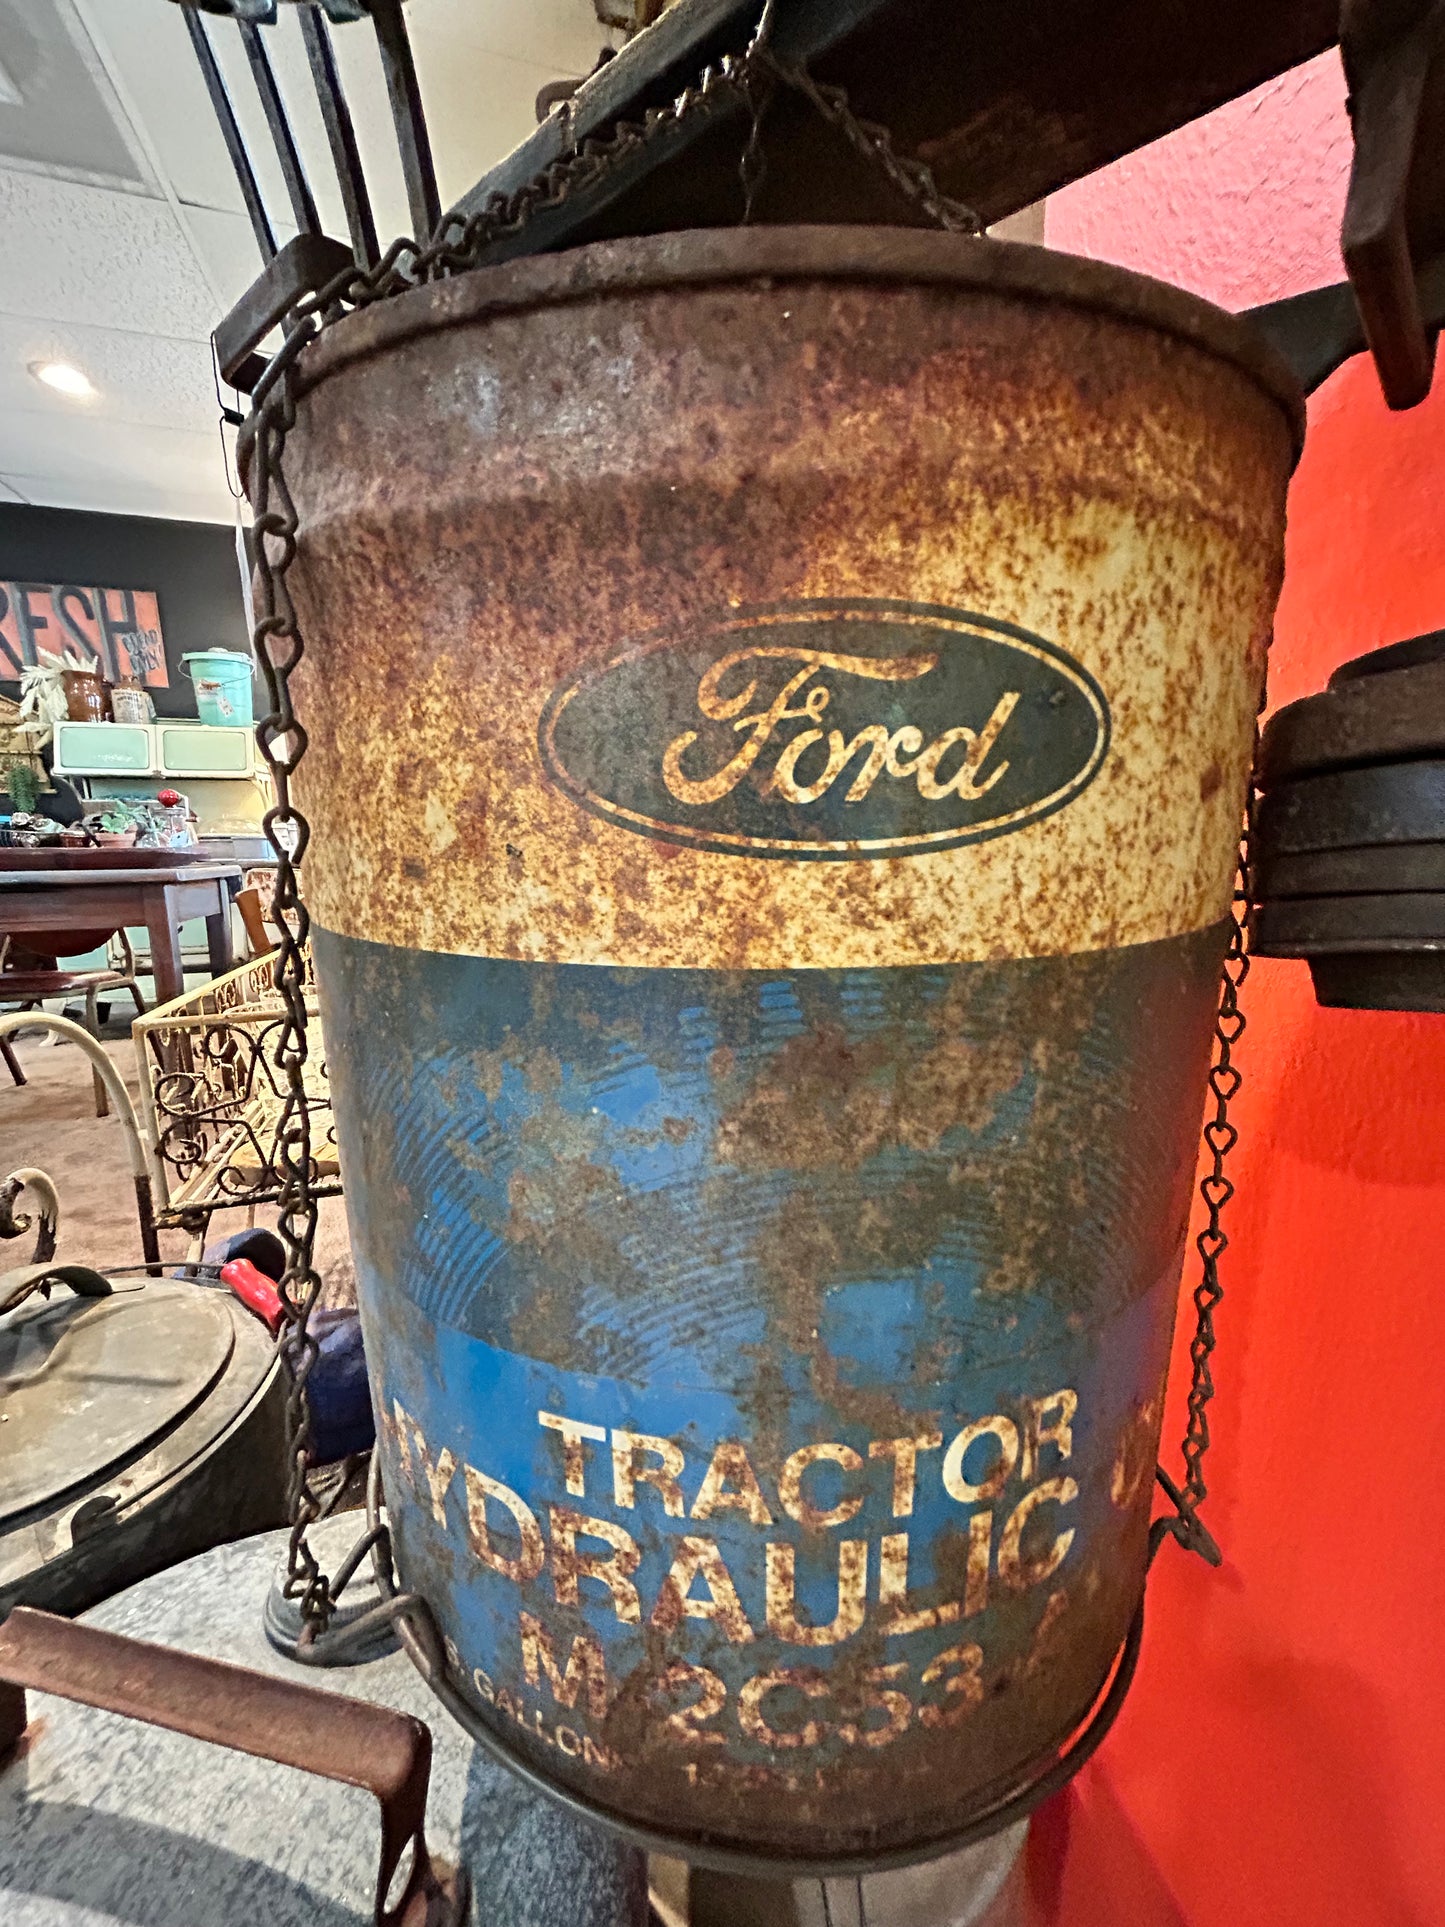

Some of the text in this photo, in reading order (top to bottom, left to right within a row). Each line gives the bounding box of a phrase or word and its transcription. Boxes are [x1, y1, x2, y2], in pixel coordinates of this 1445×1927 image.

[662, 645, 1021, 806] Ford
[376, 1396, 1080, 1647] HYDRAULIC
[537, 1387, 1079, 1529] TRACTOR
